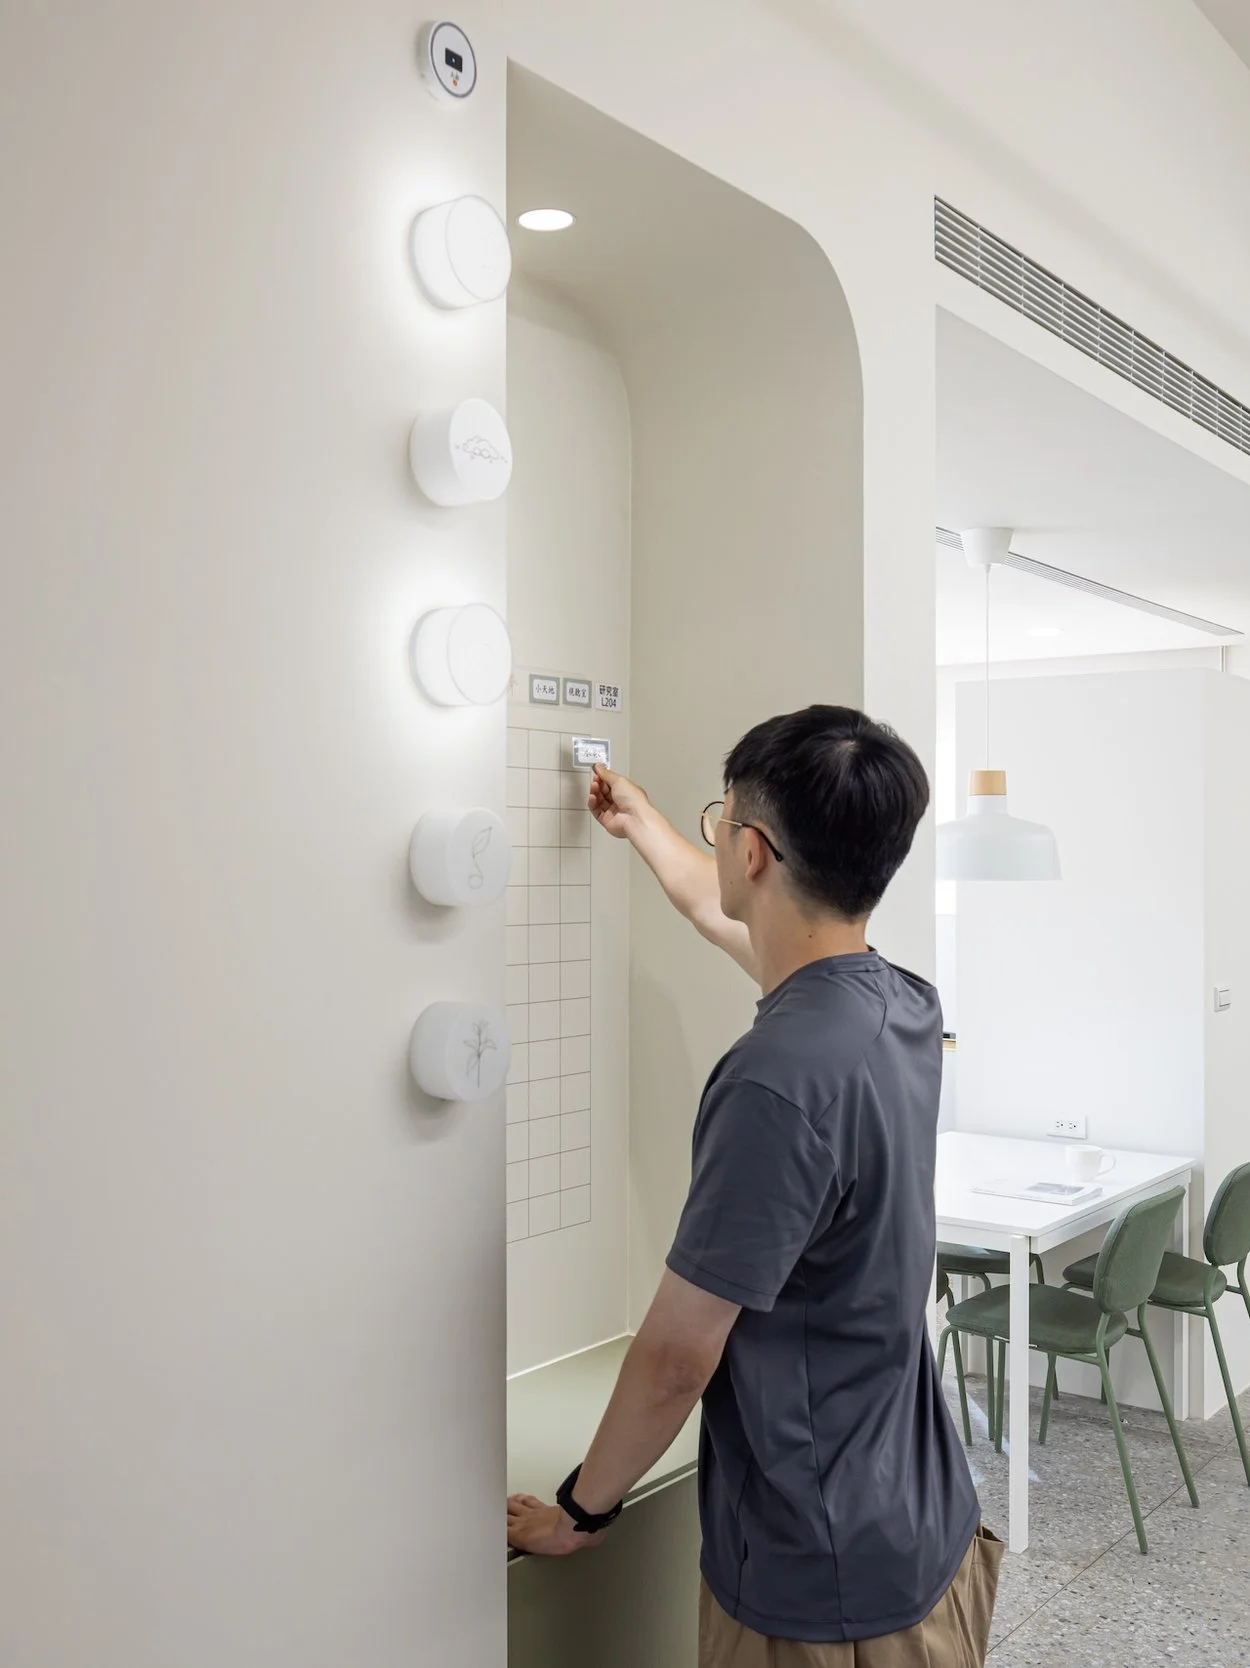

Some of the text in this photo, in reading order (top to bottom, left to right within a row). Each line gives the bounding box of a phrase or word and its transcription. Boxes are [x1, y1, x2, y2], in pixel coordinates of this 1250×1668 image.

[535, 684, 555, 695] 小天地
[599, 684, 619, 697] 研究室
[602, 697, 617, 708] L204
